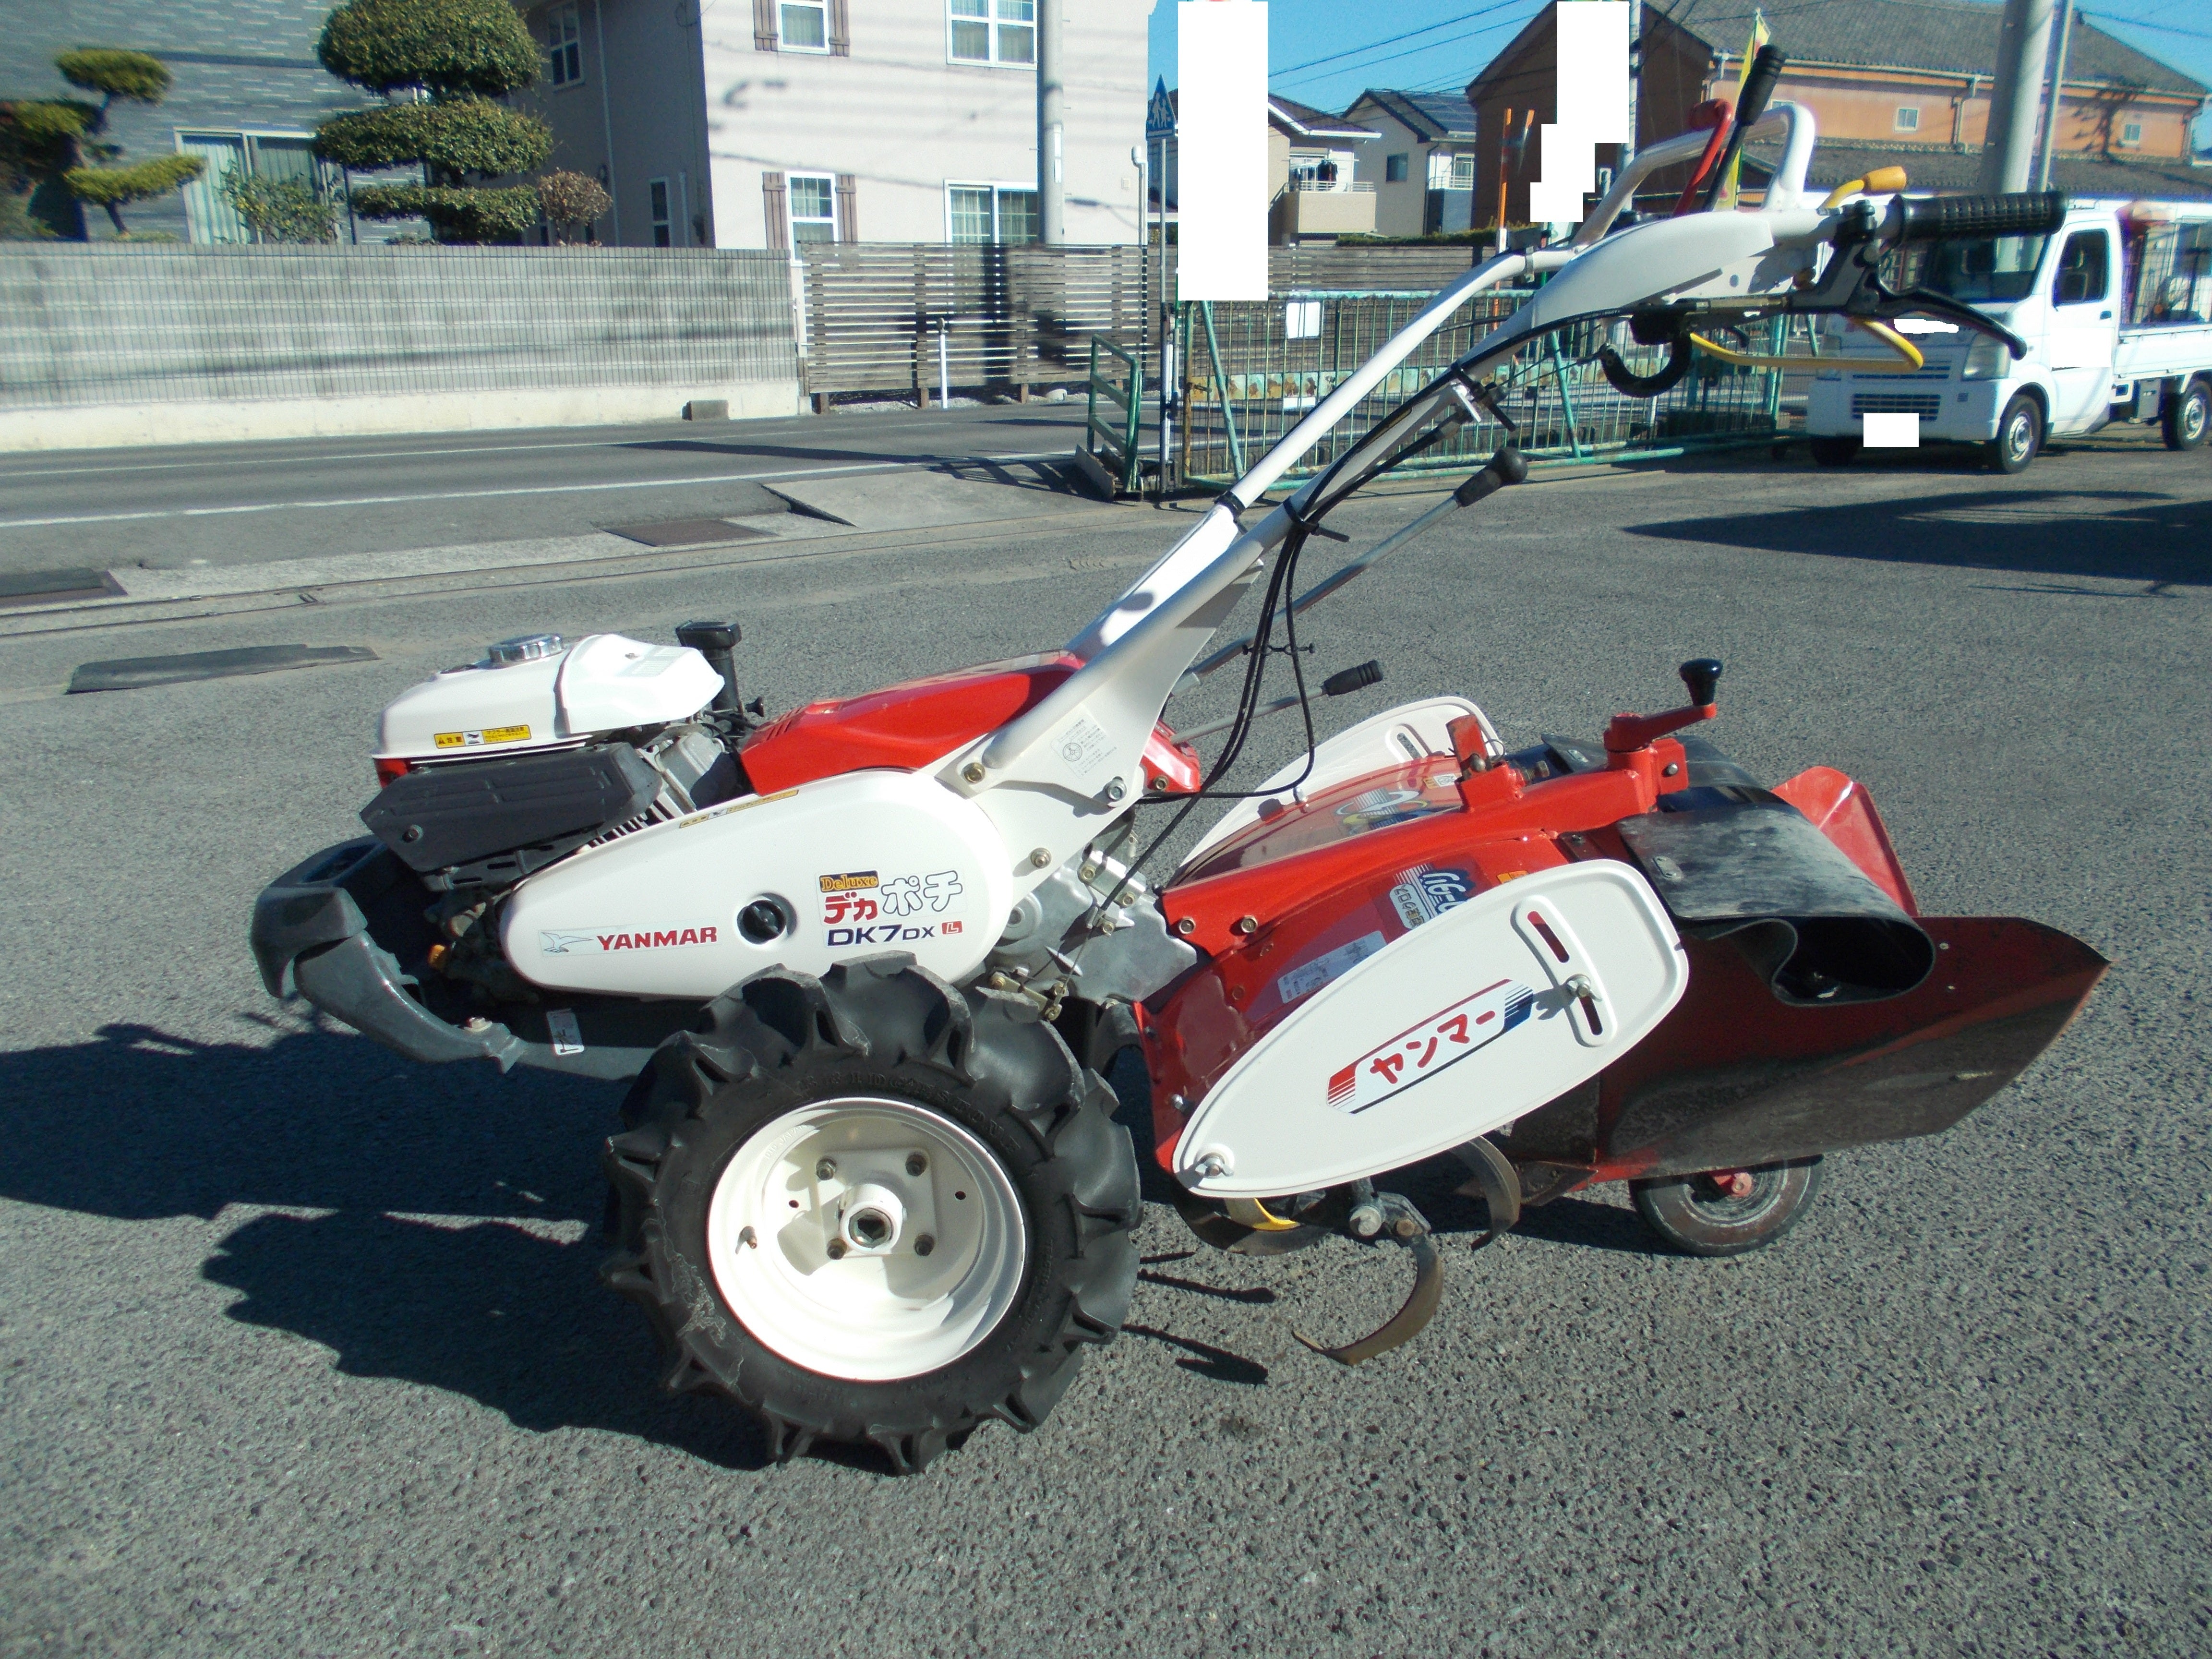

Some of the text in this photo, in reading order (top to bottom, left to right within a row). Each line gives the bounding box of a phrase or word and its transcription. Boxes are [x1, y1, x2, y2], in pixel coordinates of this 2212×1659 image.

[820, 874, 878, 891] Deluxe
[596, 926, 718, 951] YANMAR
[1370, 1010, 1496, 1084] ヤンマー
